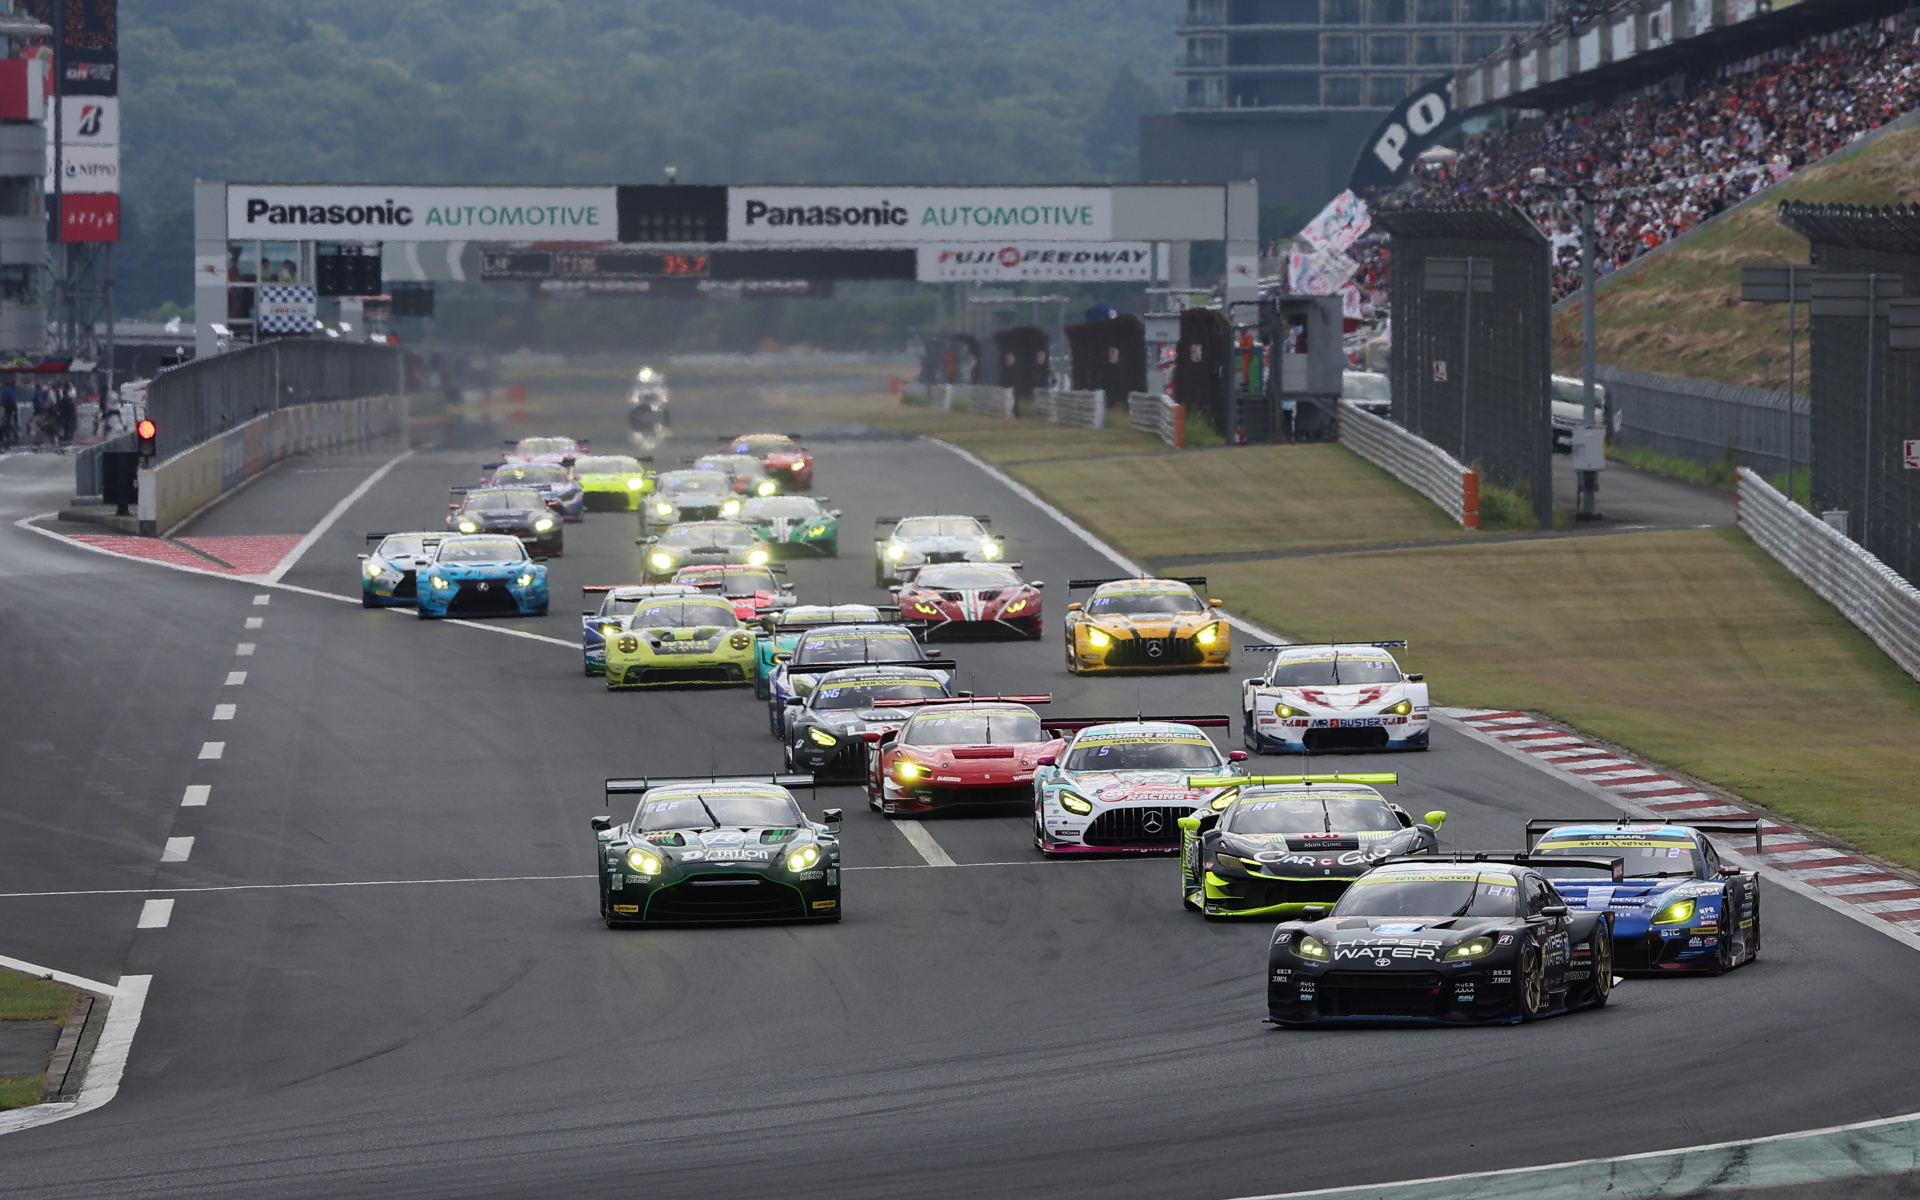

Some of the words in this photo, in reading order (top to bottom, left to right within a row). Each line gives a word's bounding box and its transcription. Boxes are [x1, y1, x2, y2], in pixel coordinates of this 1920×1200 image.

[79, 165, 117, 177] NIPPO
[247, 199, 413, 226] Panasonic
[425, 206, 600, 226] AUTOMOTIVE
[745, 200, 908, 226] Panasonic
[921, 206, 1094, 226] AUTOMOTIVE
[1340, 717, 1380, 728] BUSTER
[1080, 732, 1153, 743] GOODSMILE
[1156, 732, 1202, 740] RACING
[1668, 847, 1680, 858] 2
[1699, 907, 1715, 915] NPR
[1660, 928, 1680, 937] STC
[1335, 938, 1443, 950] HYPER
